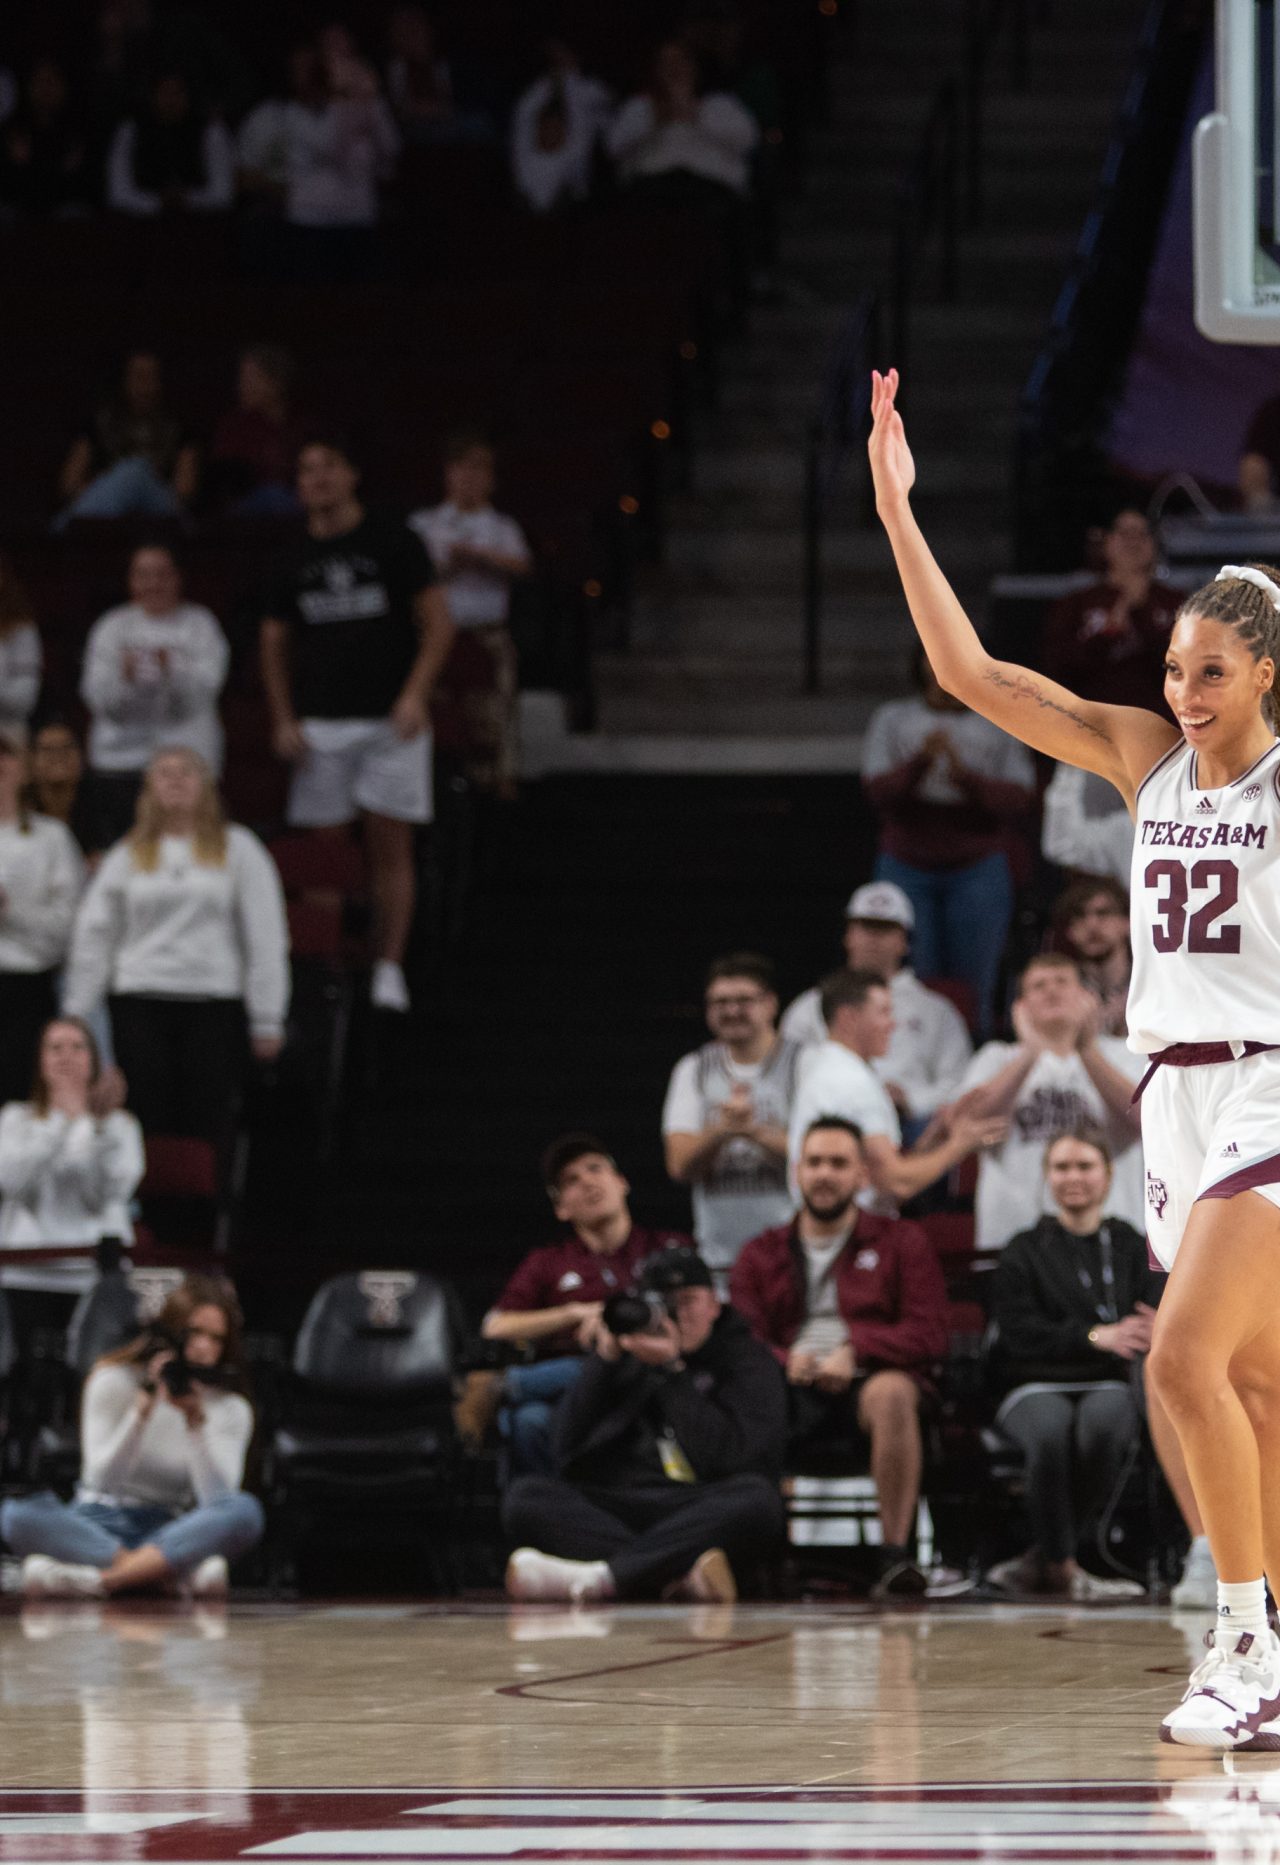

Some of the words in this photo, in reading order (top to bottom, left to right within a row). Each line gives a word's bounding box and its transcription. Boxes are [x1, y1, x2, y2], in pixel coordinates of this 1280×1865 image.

[1141, 820, 1212, 849] TEXAS
[1211, 822, 1268, 850] A&M
[1144, 859, 1241, 954] 32
